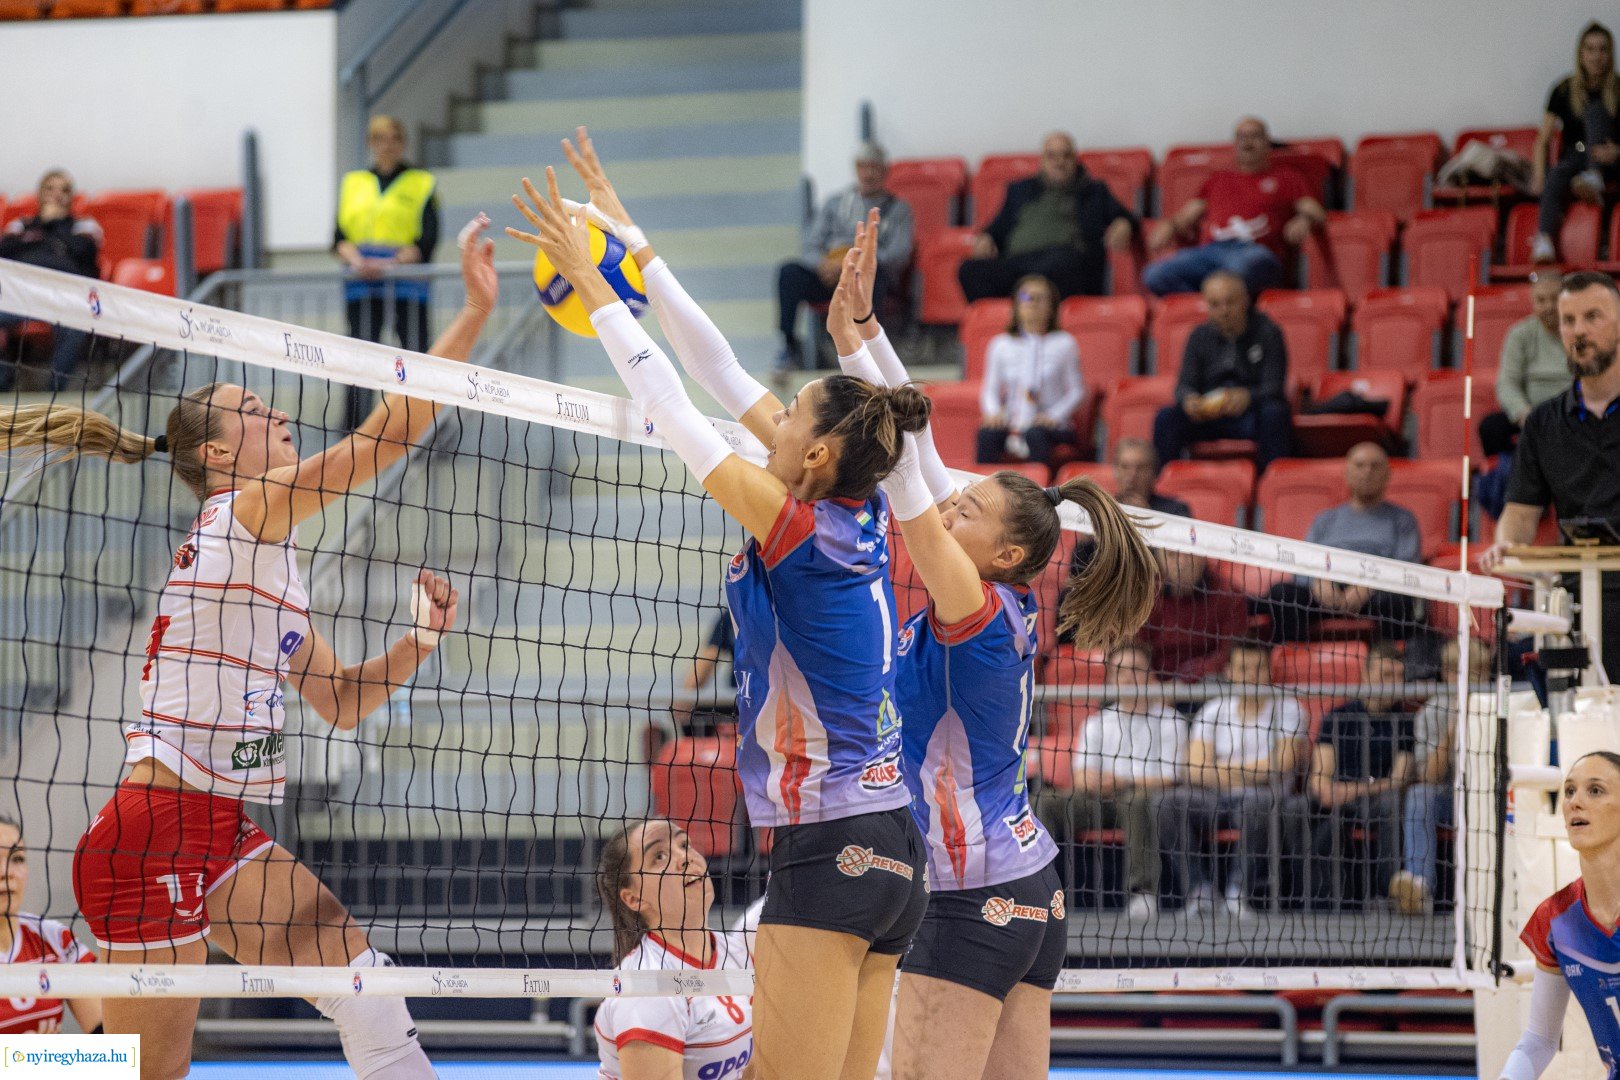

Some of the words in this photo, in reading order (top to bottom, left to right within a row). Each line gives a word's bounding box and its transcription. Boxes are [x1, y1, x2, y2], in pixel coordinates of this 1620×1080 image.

[556, 393, 590, 421] FATUM
[241, 971, 275, 993] FATUM
[523, 974, 550, 993] FATUM
